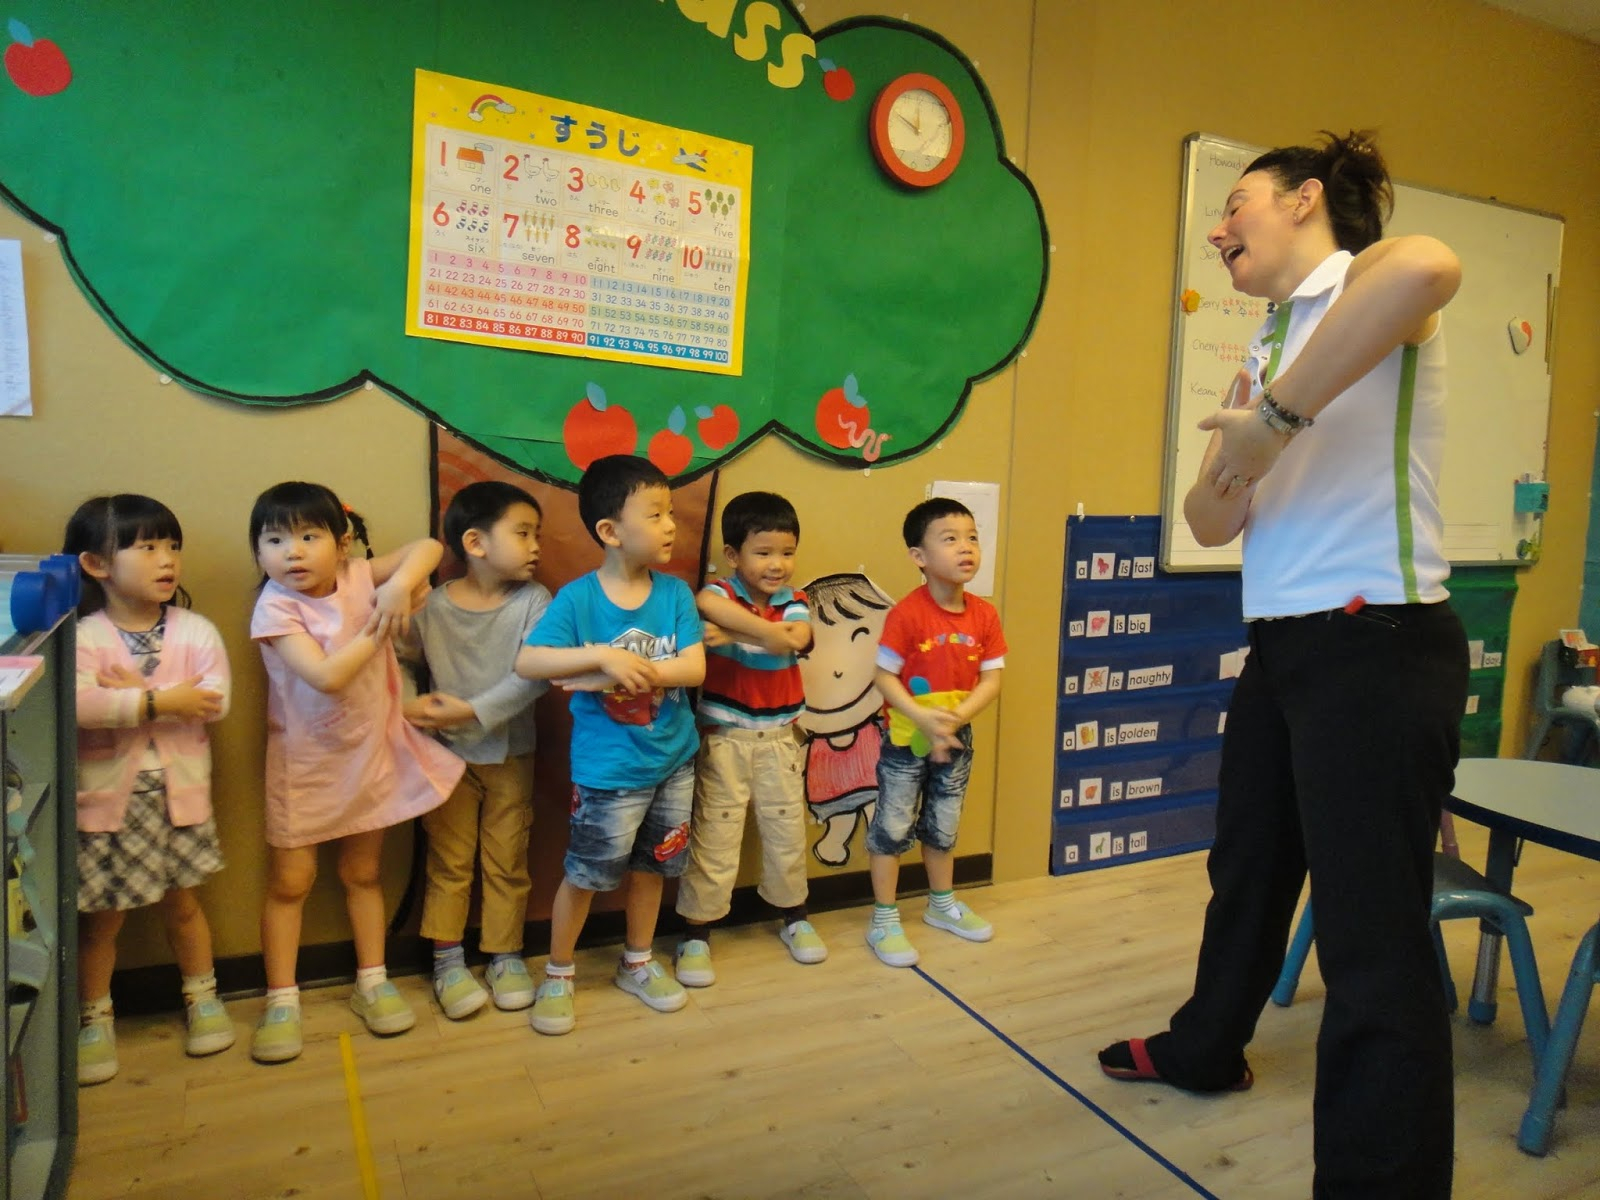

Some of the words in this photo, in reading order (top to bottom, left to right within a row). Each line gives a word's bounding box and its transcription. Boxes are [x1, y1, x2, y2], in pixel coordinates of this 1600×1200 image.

[550, 114, 640, 157] すうじ
[440, 141, 446, 166] 1
[503, 155, 519, 182] 2
[568, 167, 584, 192] 3
[630, 180, 646, 204] 4
[689, 191, 702, 215] 5
[470, 183, 491, 196] one
[535, 193, 557, 206] two
[588, 203, 619, 218] three
[653, 214, 678, 228] four
[713, 225, 734, 239] five
[433, 202, 450, 227] 6
[503, 214, 520, 238] 7
[565, 225, 581, 248] 8
[626, 235, 642, 259] 9
[682, 245, 703, 270] 10
[450, 256, 456, 264] 2
[467, 259, 472, 267] 3
[483, 261, 489, 269] 4
[499, 264, 504, 272] 5
[515, 266, 520, 274] 6
[546, 271, 552, 279] 8
[562, 273, 567, 281] 9
[576, 276, 586, 284] 10
[593, 278, 601, 286] 11
[608, 280, 617, 290] 12
[623, 282, 632, 292] 13
[638, 285, 646, 294] 14
[652, 287, 661, 296] 15
[666, 289, 675, 298] 16
[680, 291, 689, 300] 17
[694, 293, 702, 302] 18
[707, 296, 716, 304] 19
[720, 298, 729, 306] 20
[468, 242, 485, 253] six
[522, 250, 555, 265] seven
[587, 261, 615, 274] eight
[652, 271, 675, 283] nine
[713, 281, 731, 292] ten
[428, 284, 439, 293] 41
[445, 286, 457, 296] 42
[461, 289, 474, 298] 43
[478, 291, 490, 300] 44
[494, 294, 506, 302] 45
[510, 296, 522, 304] 46
[527, 298, 538, 306] 47
[542, 300, 553, 308] 48
[558, 302, 569, 310] 49
[572, 304, 584, 313] 50
[591, 307, 600, 315] 51
[605, 309, 616, 318] 52
[620, 311, 631, 320] 53
[635, 313, 645, 322] 54
[649, 315, 660, 324] 55
[663, 317, 674, 326] 56
[677, 319, 687, 327] 57
[691, 321, 701, 330] 58
[704, 323, 714, 331] 59
[718, 325, 728, 334] 60
[430, 268, 440, 277] 21
[446, 271, 458, 280] 22
[463, 273, 474, 282] 23
[479, 276, 491, 285] 24
[496, 279, 506, 288] 25
[511, 281, 523, 290] 26
[528, 283, 539, 292] 27
[543, 285, 554, 294] 28
[559, 287, 570, 296] 29
[574, 289, 584, 298] 30
[592, 293, 601, 301] 31
[606, 295, 617, 304] 32
[621, 297, 632, 306] 33
[635, 299, 646, 308] 34
[650, 302, 660, 310] 35
[664, 304, 674, 312] 36
[678, 306, 688, 314] 37
[691, 307, 701, 316] 38
[705, 309, 715, 317] 39
[718, 311, 728, 320] 40
[427, 314, 438, 324] 81
[443, 316, 455, 326] 82
[460, 319, 472, 328] 83
[476, 321, 489, 330] 84
[493, 323, 505, 333] 85
[509, 325, 521, 334] 86
[525, 327, 537, 336] 87
[541, 329, 552, 338] 88
[556, 331, 568, 340] 89
[571, 333, 583, 342] 90
[590, 336, 599, 344] 91
[604, 337, 615, 346] 92
[618, 340, 629, 348] 93
[633, 342, 644, 350] 94
[648, 344, 658, 352] 95
[662, 345, 673, 354] 96
[676, 347, 686, 356] 97
[689, 349, 700, 357] 98
[703, 350, 713, 359] 99
[716, 352, 727, 361] 100
[428, 299, 438, 308] 61
[444, 302, 456, 311] 62
[460, 304, 473, 313] 63
[477, 306, 489, 315] 64
[494, 309, 505, 318] 65
[510, 311, 521, 320] 66
[526, 313, 537, 321] 67
[542, 315, 553, 323] 68
[557, 317, 568, 325] 69
[572, 319, 584, 328] 70
[591, 321, 600, 330] 71
[605, 323, 616, 332] 72
[619, 325, 630, 334] 73
[635, 327, 645, 336] 74
[649, 329, 659, 337] 75
[663, 331, 673, 340] 76
[676, 333, 686, 341] 77
[690, 335, 700, 343] 78
[704, 336, 714, 344] 79
[717, 339, 727, 347] 80
[1192, 339, 1219, 356] Cherry
[1190, 382, 1217, 397] Keanu
[1079, 567, 1085, 576] a
[1121, 563, 1128, 574] is
[1134, 562, 1152, 573] fast
[1071, 623, 1082, 632] an
[1116, 620, 1123, 630] is
[1130, 620, 1145, 632] big
[1069, 682, 1076, 690] a
[1112, 677, 1120, 686] is
[1129, 671, 1171, 685] naughty
[1066, 738, 1072, 746] a
[1107, 733, 1114, 743] is
[1120, 728, 1156, 742] golden
[1064, 795, 1070, 804] a
[1113, 787, 1120, 797] is
[1129, 784, 1160, 795] brown
[1069, 851, 1075, 859] a
[1116, 841, 1122, 851] is
[1131, 836, 1145, 848] tall
